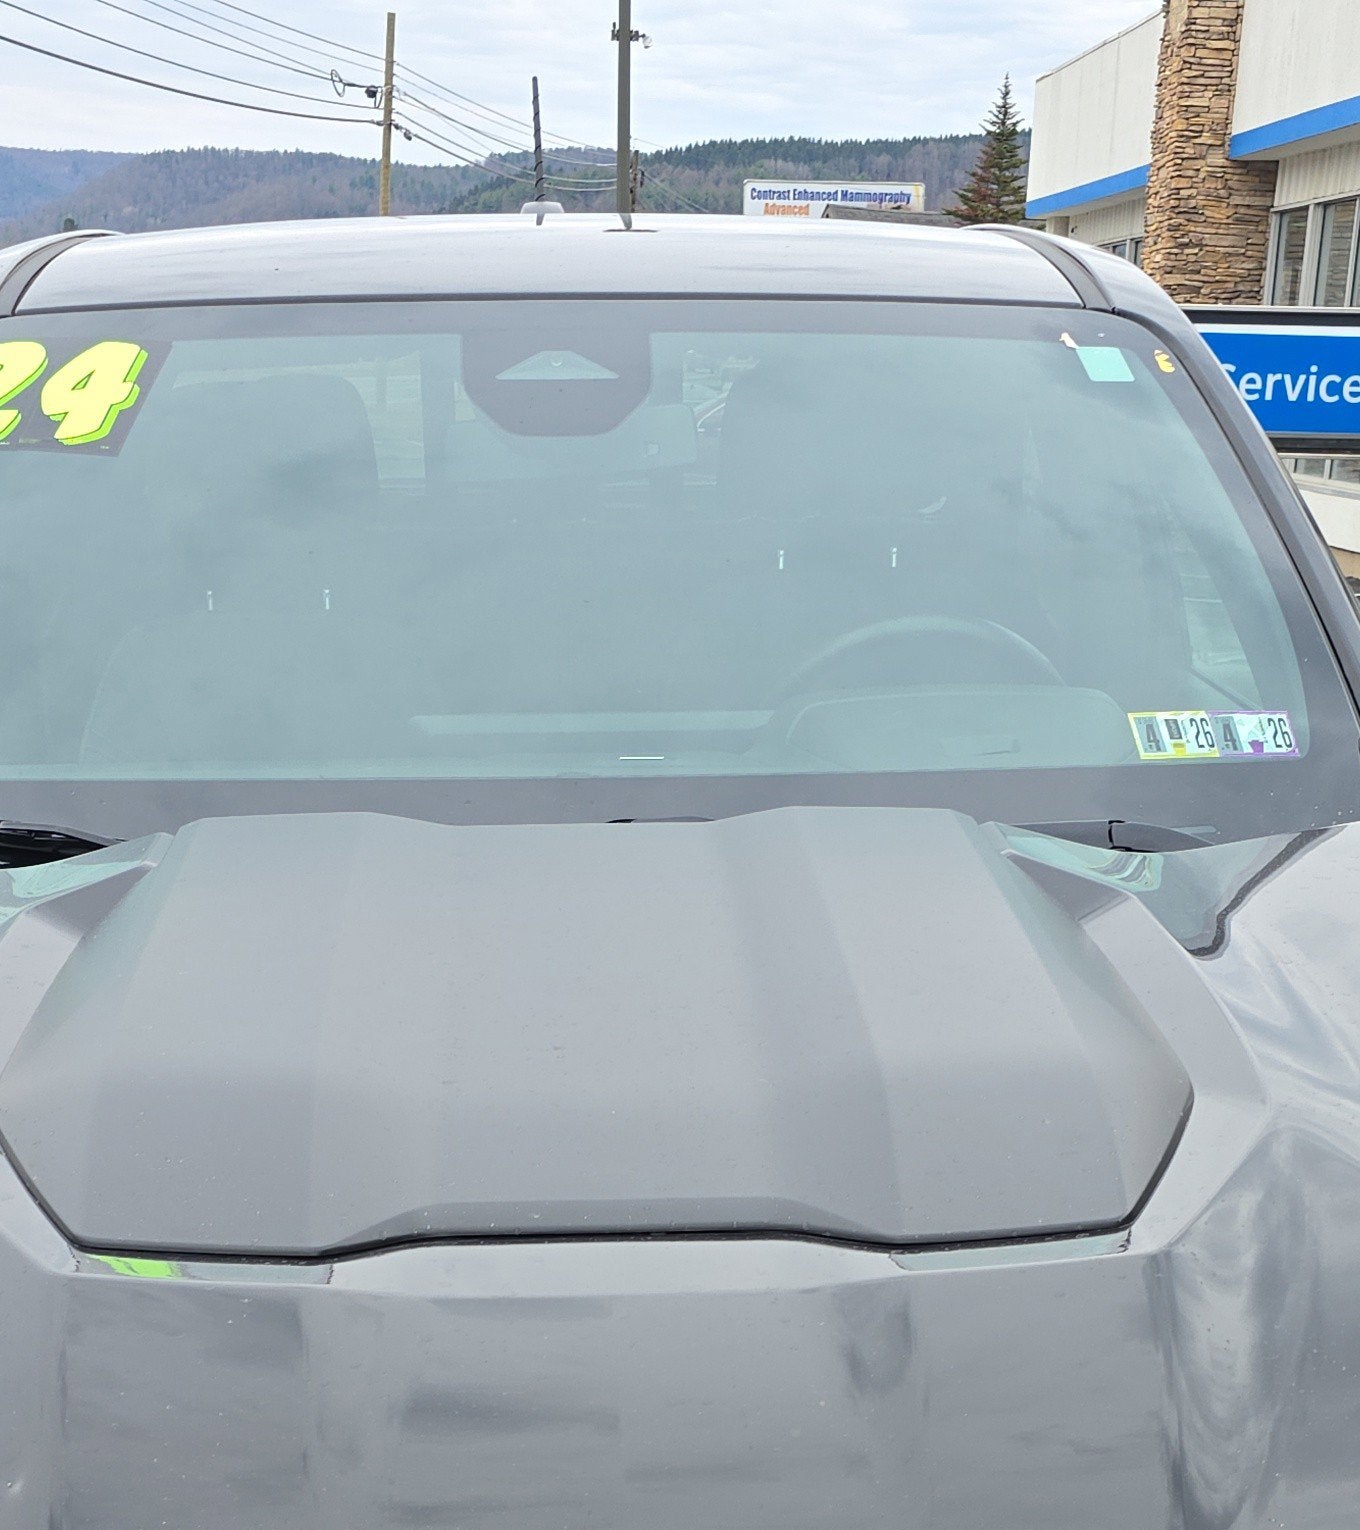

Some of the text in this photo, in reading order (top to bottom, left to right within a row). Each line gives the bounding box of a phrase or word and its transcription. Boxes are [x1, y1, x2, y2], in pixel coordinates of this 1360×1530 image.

[750, 187, 912, 206] Contrast Enhanced Mammography
[763, 203, 810, 216] Advanced
[1190, 717, 1215, 749] 26
[1267, 717, 1293, 749] 26
